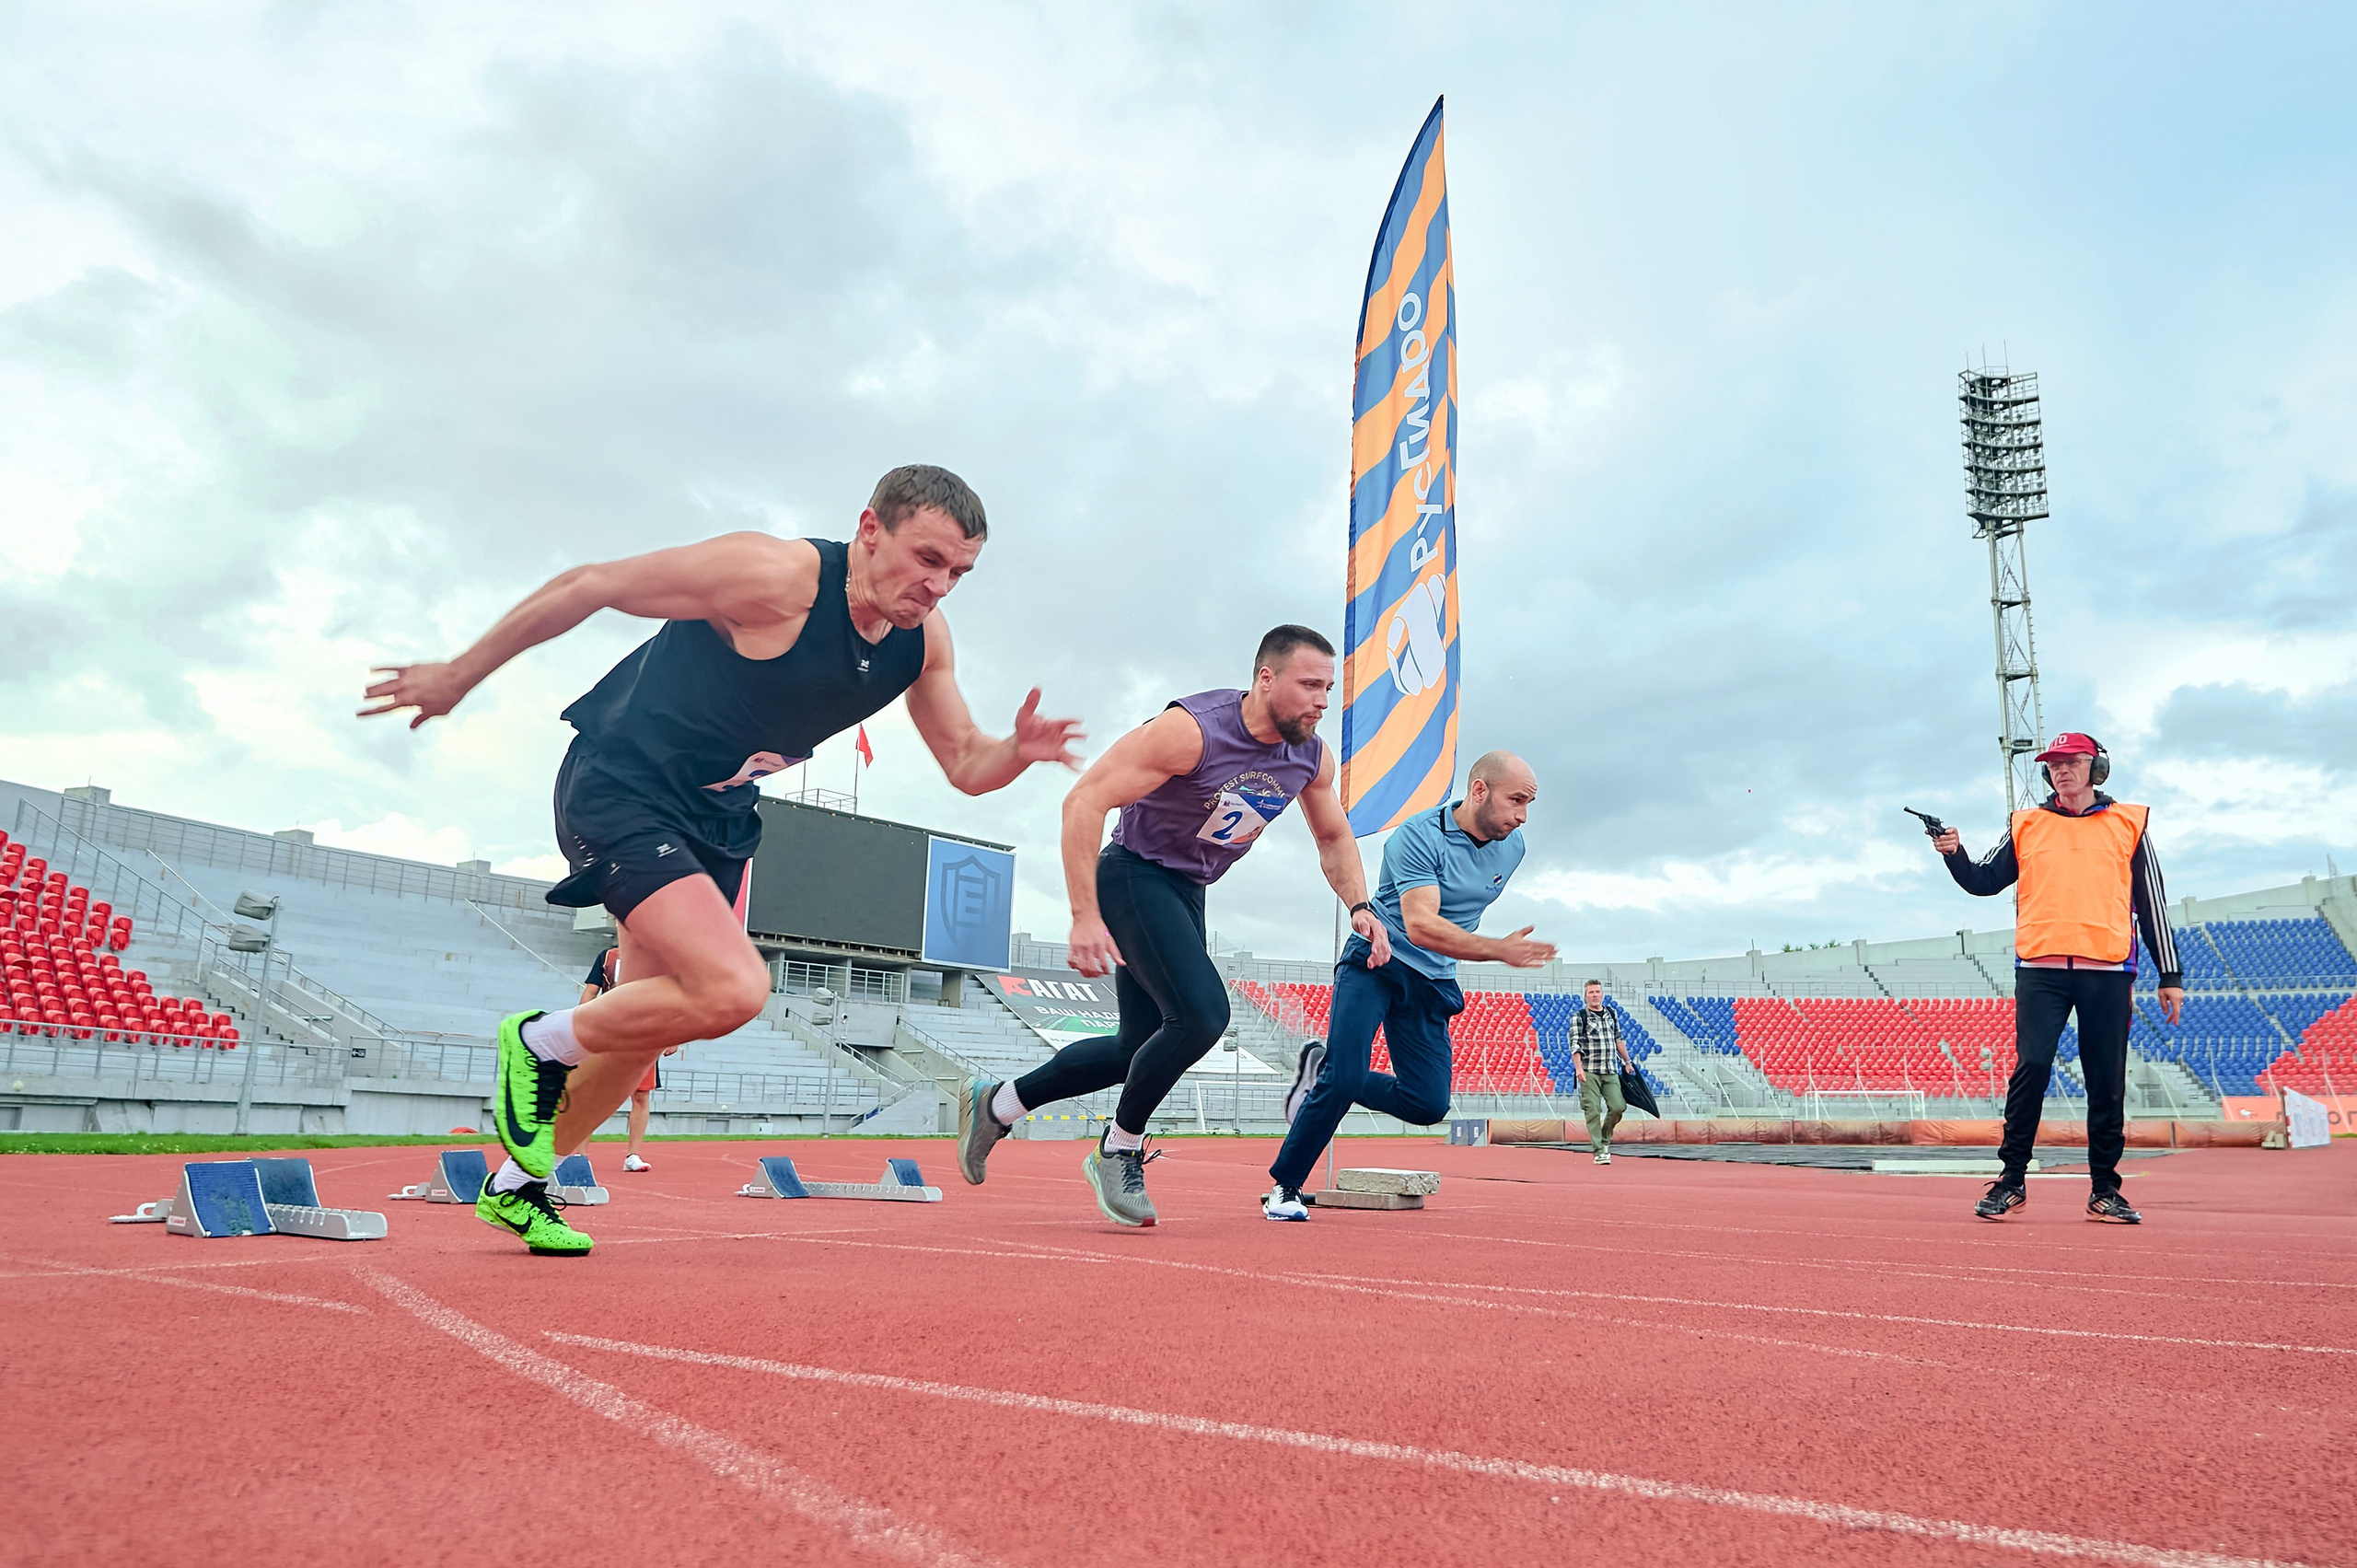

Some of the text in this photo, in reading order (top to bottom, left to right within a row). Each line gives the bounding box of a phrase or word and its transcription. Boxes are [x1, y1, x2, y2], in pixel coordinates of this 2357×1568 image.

[1203, 776, 1238, 809] PROTEST
[1239, 771, 1262, 783] SURF
[1211, 810, 1243, 841] 2
[1027, 978, 1100, 1003] АГАТ
[1034, 1005, 1077, 1017] ВАШ
